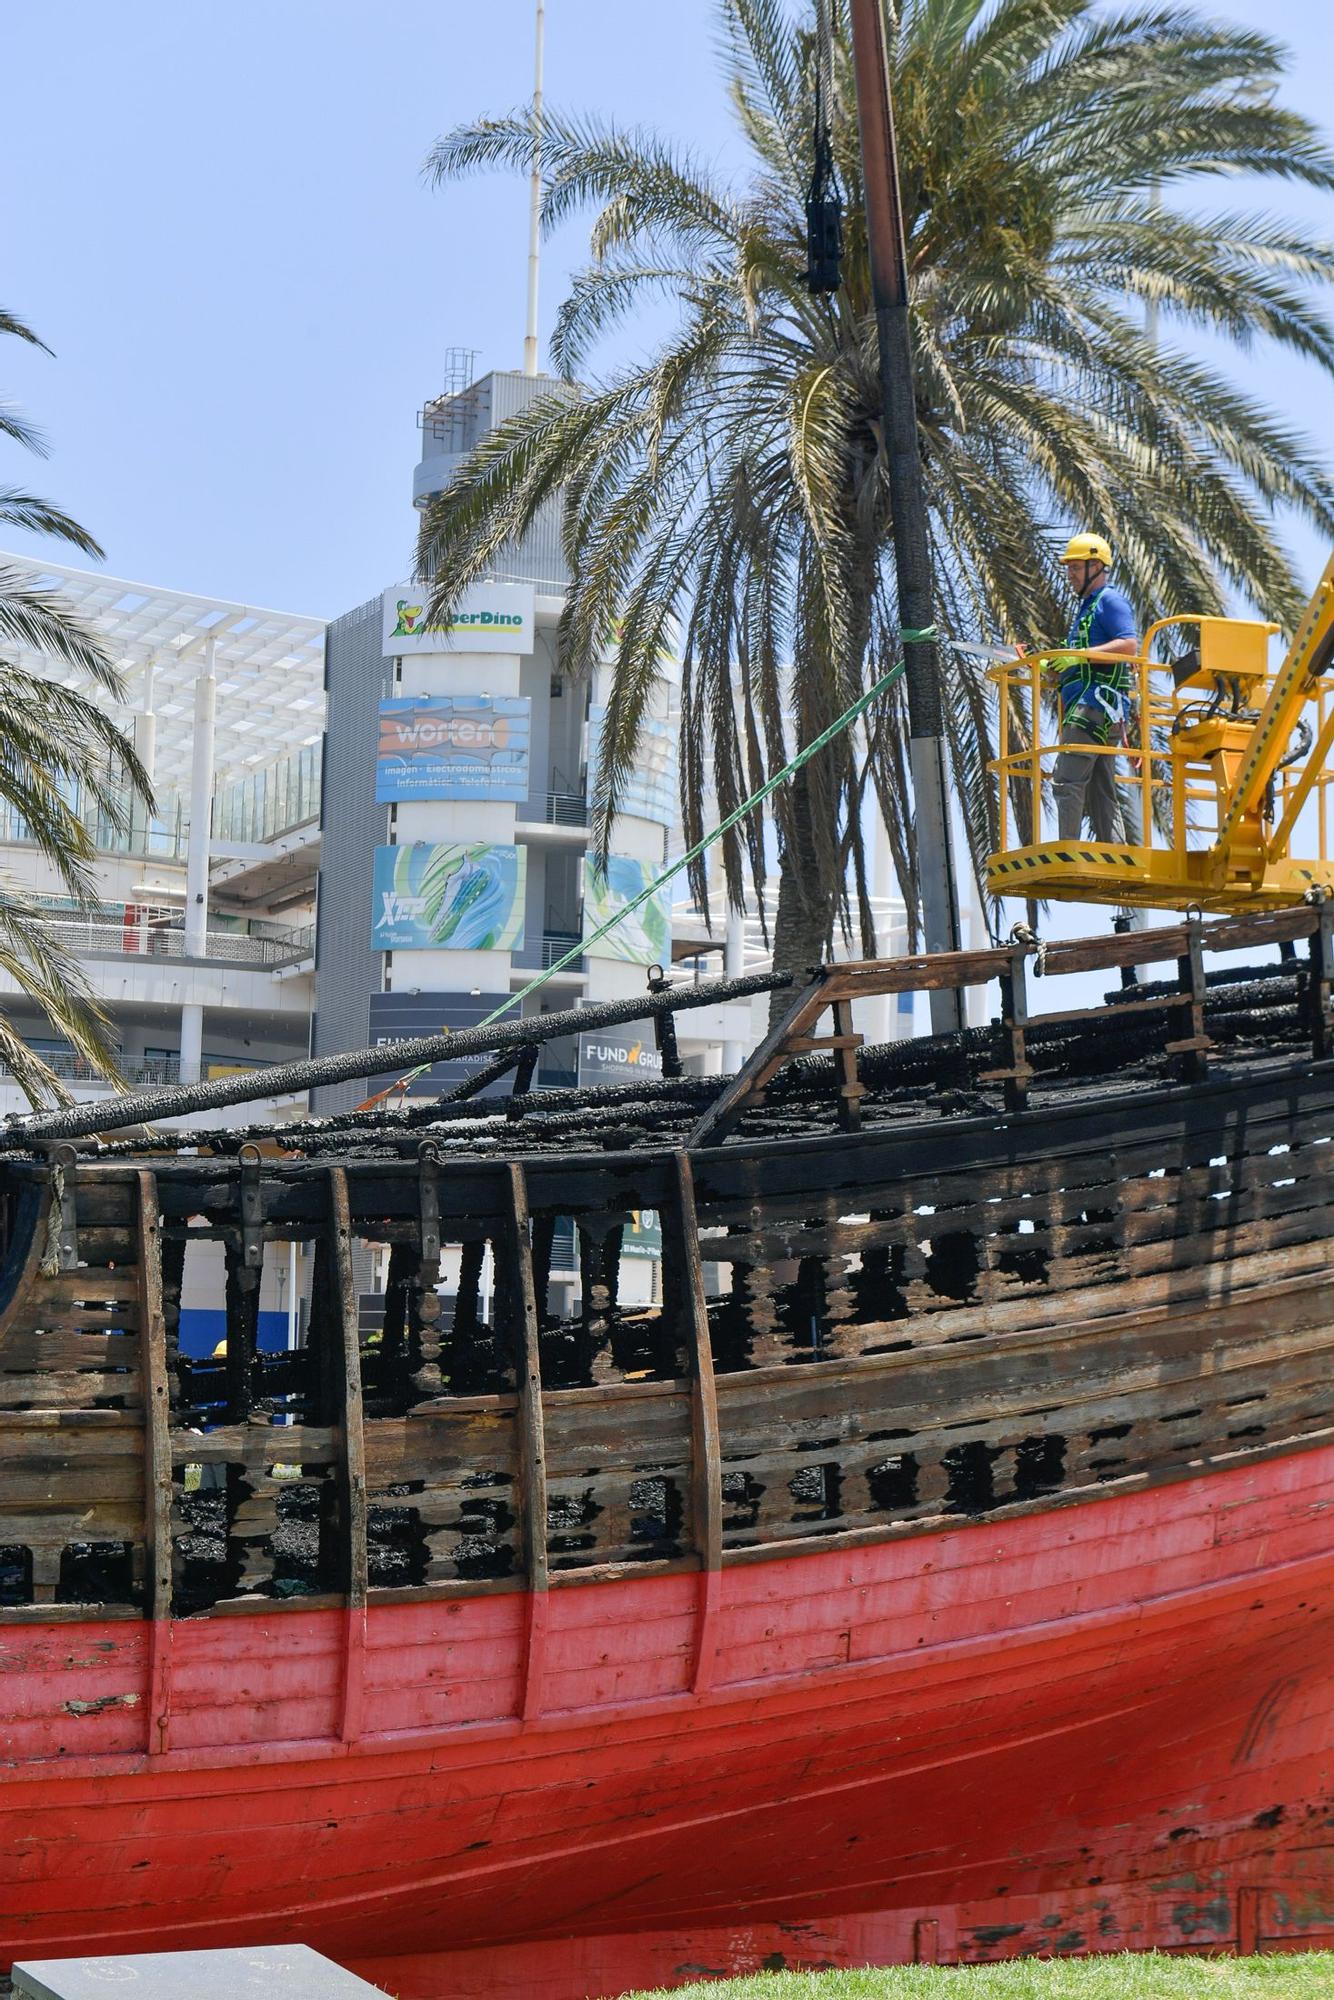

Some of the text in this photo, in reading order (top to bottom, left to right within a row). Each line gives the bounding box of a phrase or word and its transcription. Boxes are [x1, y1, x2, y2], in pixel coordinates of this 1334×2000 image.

[447, 610, 523, 626] perDino
[396, 720, 495, 743] worten
[384, 767, 418, 777] Imagen
[586, 1044, 663, 1070] FUND GRU
